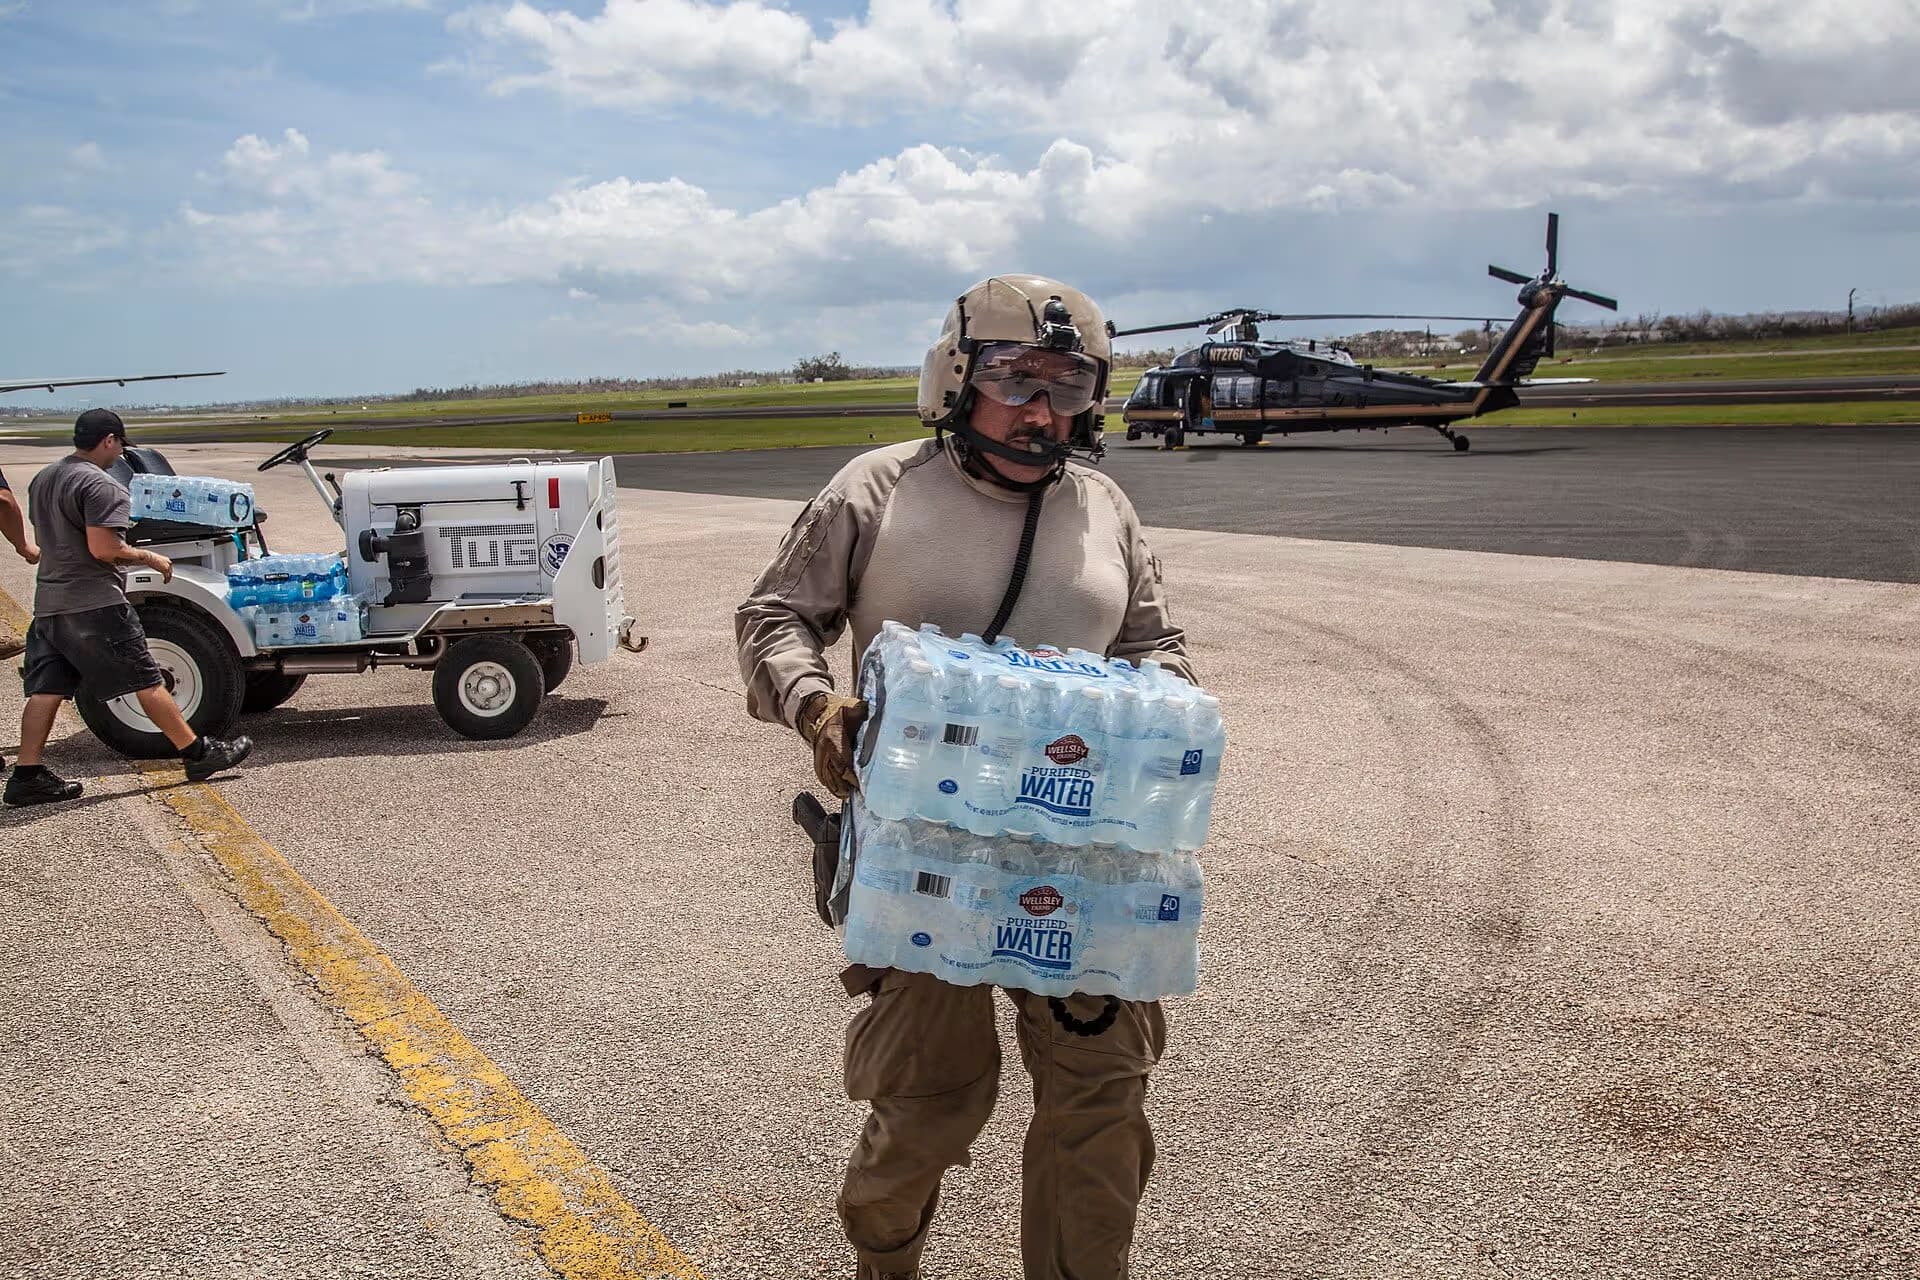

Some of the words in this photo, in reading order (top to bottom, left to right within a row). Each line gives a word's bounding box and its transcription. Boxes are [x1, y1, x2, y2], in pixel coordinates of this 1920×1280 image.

[439, 523, 537, 568] TUG
[1002, 651, 1103, 675] WATER
[1047, 743, 1087, 756] WELLSLEY
[1185, 751, 1200, 765] 40
[1031, 766, 1091, 779] PURIFIED
[1021, 774, 1094, 807] WATER
[1021, 895, 1062, 906] WELLSLEY
[1162, 896, 1178, 911] 40
[1007, 917, 1068, 930] PURIFIED
[997, 926, 1072, 961] WATER
